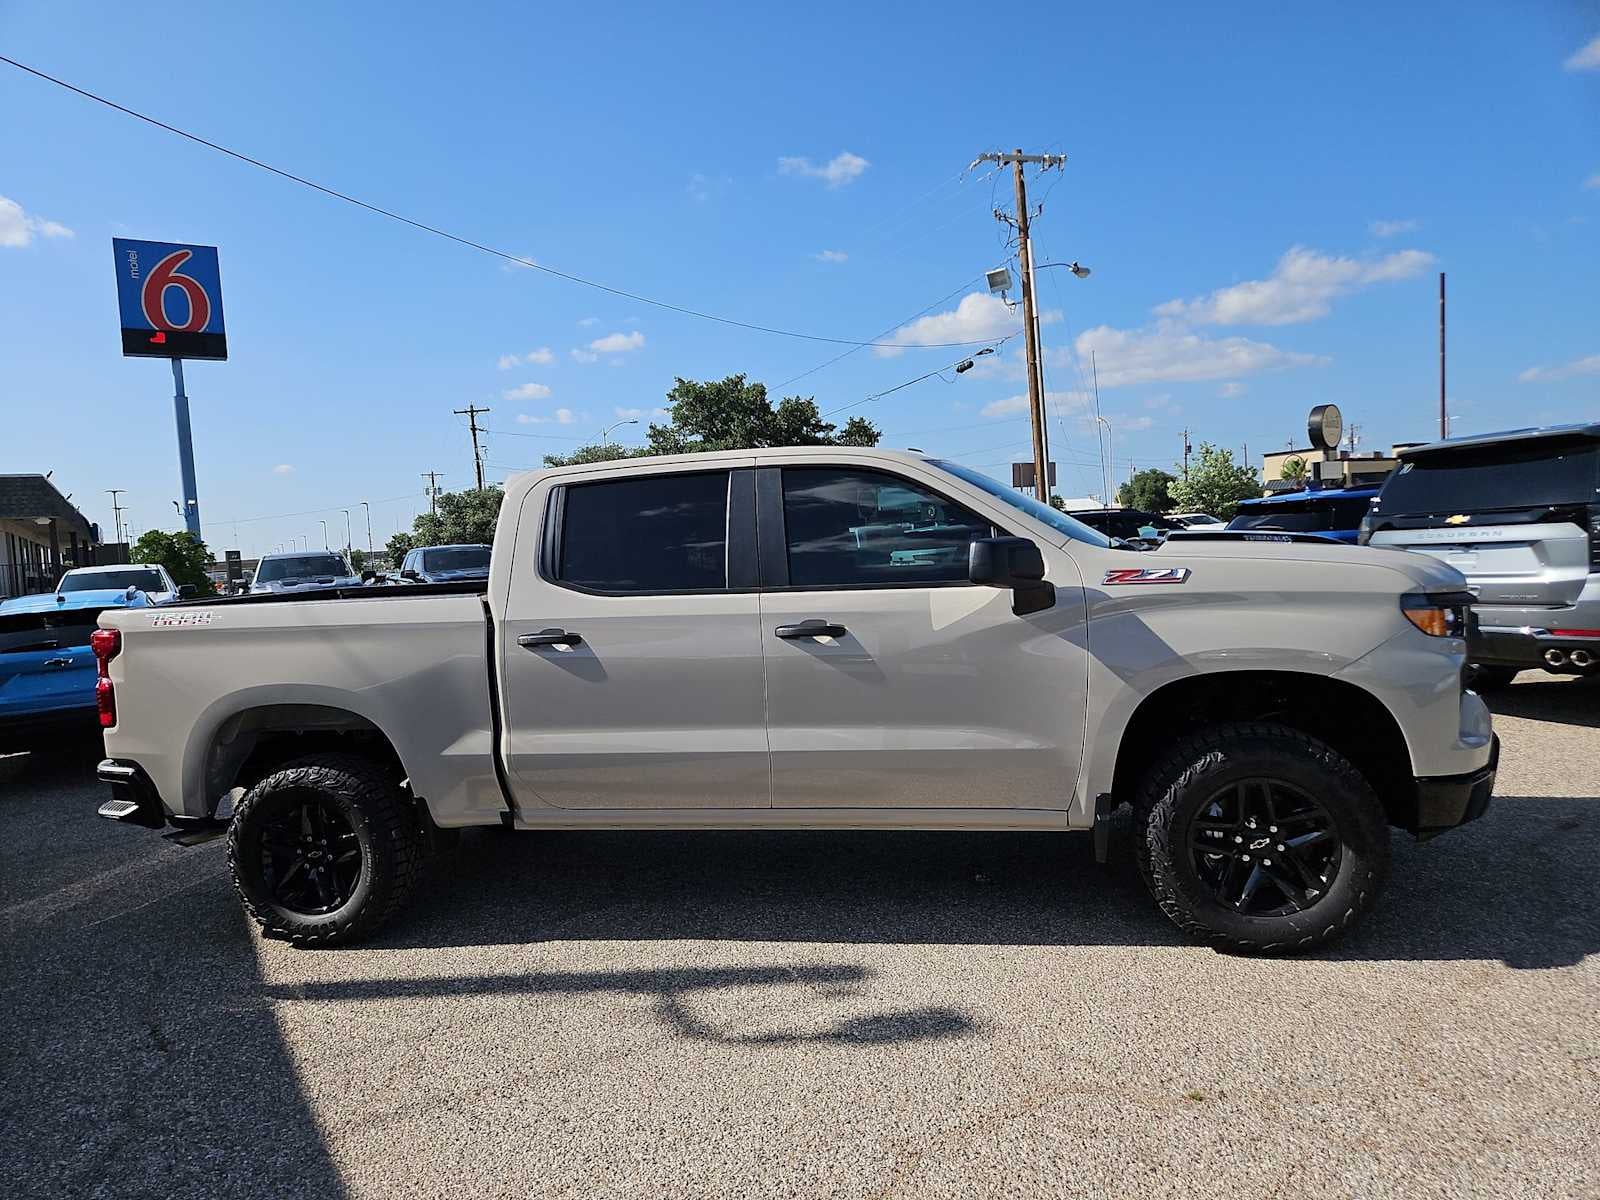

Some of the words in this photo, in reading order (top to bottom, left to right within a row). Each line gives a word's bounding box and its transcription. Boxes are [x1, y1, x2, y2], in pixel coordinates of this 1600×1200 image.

[127, 249, 139, 279] motel
[141, 248, 211, 333] 6
[1102, 568, 1190, 585] Z71
